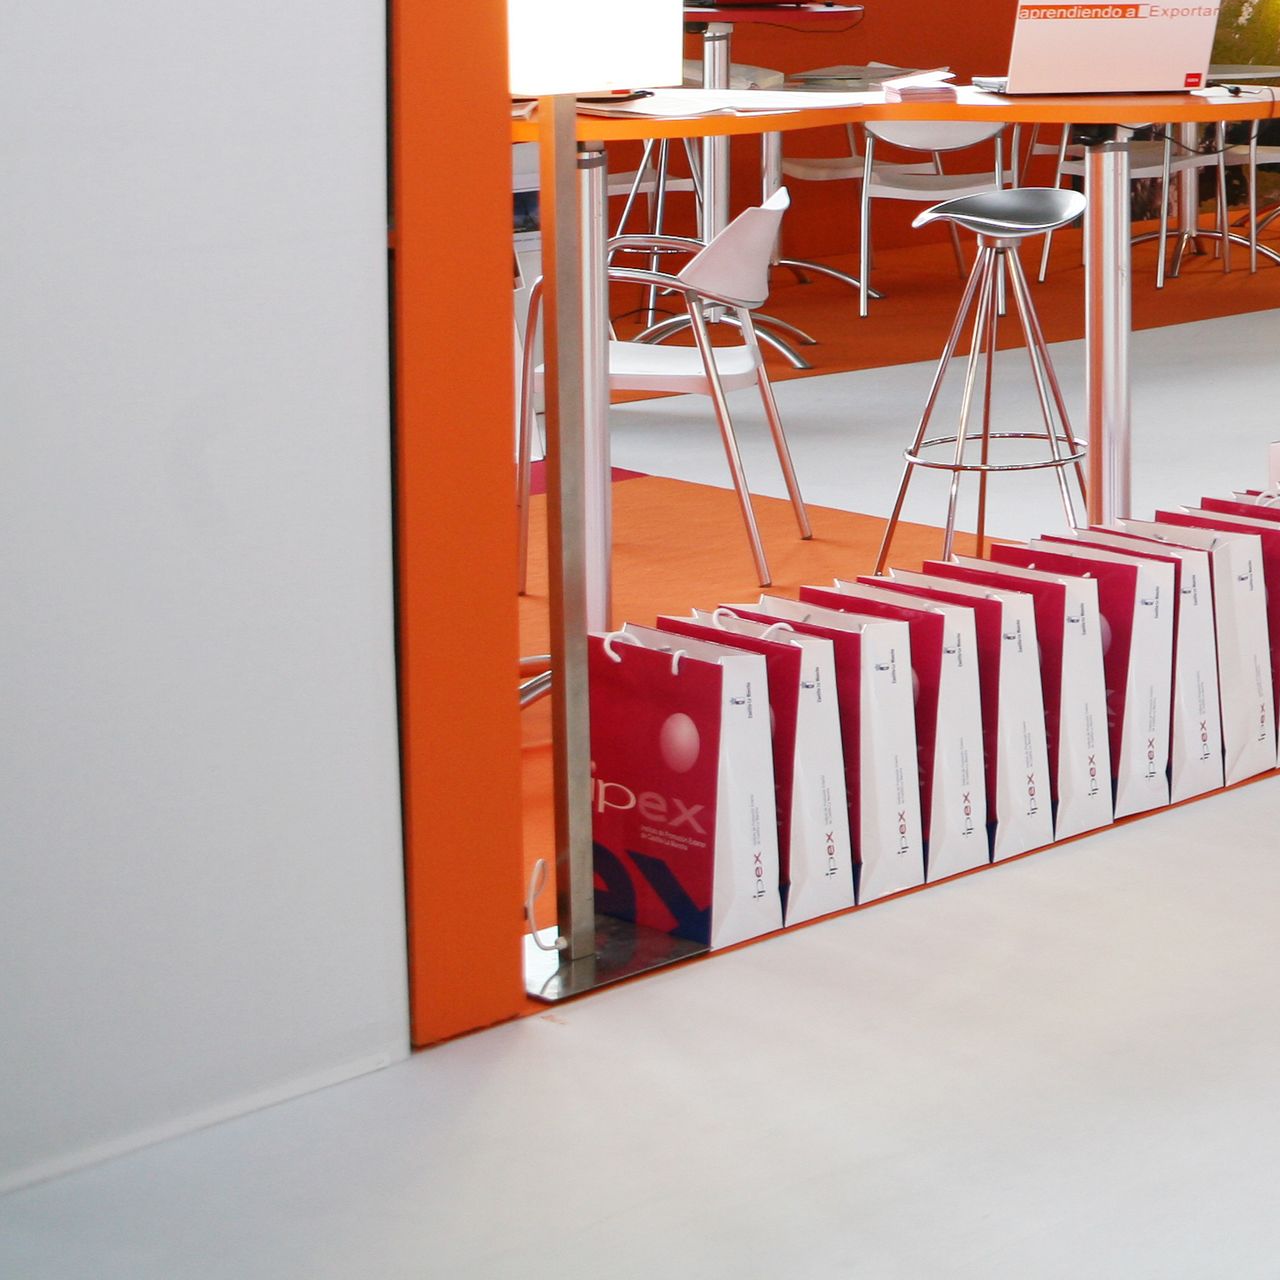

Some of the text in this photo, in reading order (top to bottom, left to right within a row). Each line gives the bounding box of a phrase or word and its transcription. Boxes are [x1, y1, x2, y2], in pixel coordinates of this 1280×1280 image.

[1019, 5, 1222, 20] aprendiendo a Exportar
